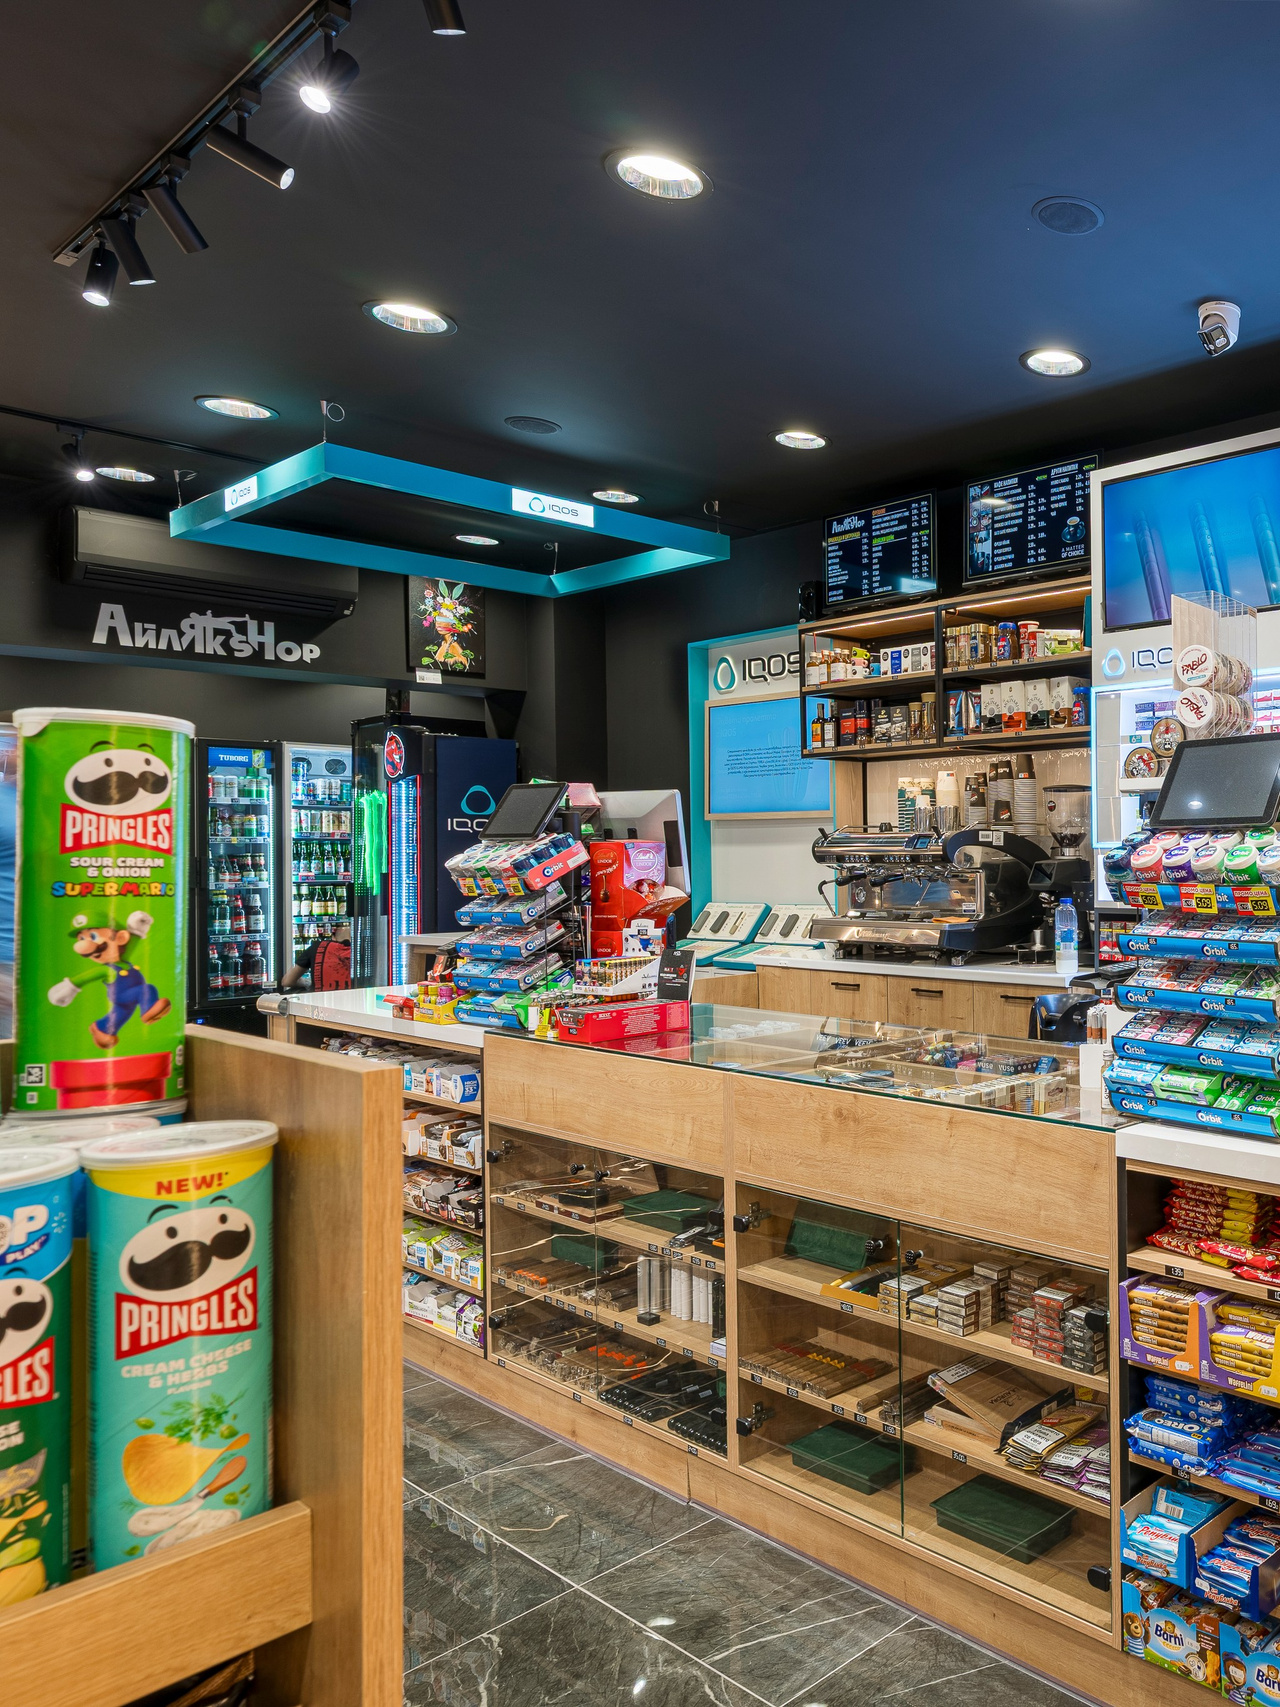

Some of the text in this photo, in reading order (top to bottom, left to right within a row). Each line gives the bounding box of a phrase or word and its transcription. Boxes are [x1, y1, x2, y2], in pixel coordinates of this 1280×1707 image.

[547, 503, 579, 518] IQOS
[1132, 647, 1173, 668] IQO
[1181, 653, 1208, 676] PABLO
[1180, 697, 1206, 721] PABLO
[218, 754, 249, 762] TUBORG
[65, 810, 170, 850] PRINGLES
[447, 818, 489, 833] IQO
[70, 856, 164, 868] SOUR CREAM
[86, 867, 151, 877] & ONION
[543, 862, 564, 878] Orbit
[51, 882, 175, 897] SUPER MARIO
[1196, 898, 1211, 908] 5.09
[1251, 901, 1268, 910] 5.09
[525, 936, 544, 952] Orbit
[524, 970, 543, 985] Orbit
[1201, 999, 1226, 1012] Orbit
[1123, 1042, 1146, 1057] Orbit
[1198, 1052, 1224, 1068] Orbit
[1120, 1096, 1144, 1112] Orbit
[1196, 1109, 1223, 1124] Orbit
[1172, 1267, 1181, 1276] 1.39
[121, 1278, 254, 1352] PRINGLES
[121, 1339, 252, 1378] CREAM CHEESE
[148, 1360, 229, 1388] & HERBS
[1154, 1418, 1201, 1432] OREO
[1265, 1498, 1277, 1509] 1.69
[1136, 1555, 1167, 1569] Република
[1204, 1592, 1238, 1605] Република
[1154, 1624, 1185, 1646] Barni
